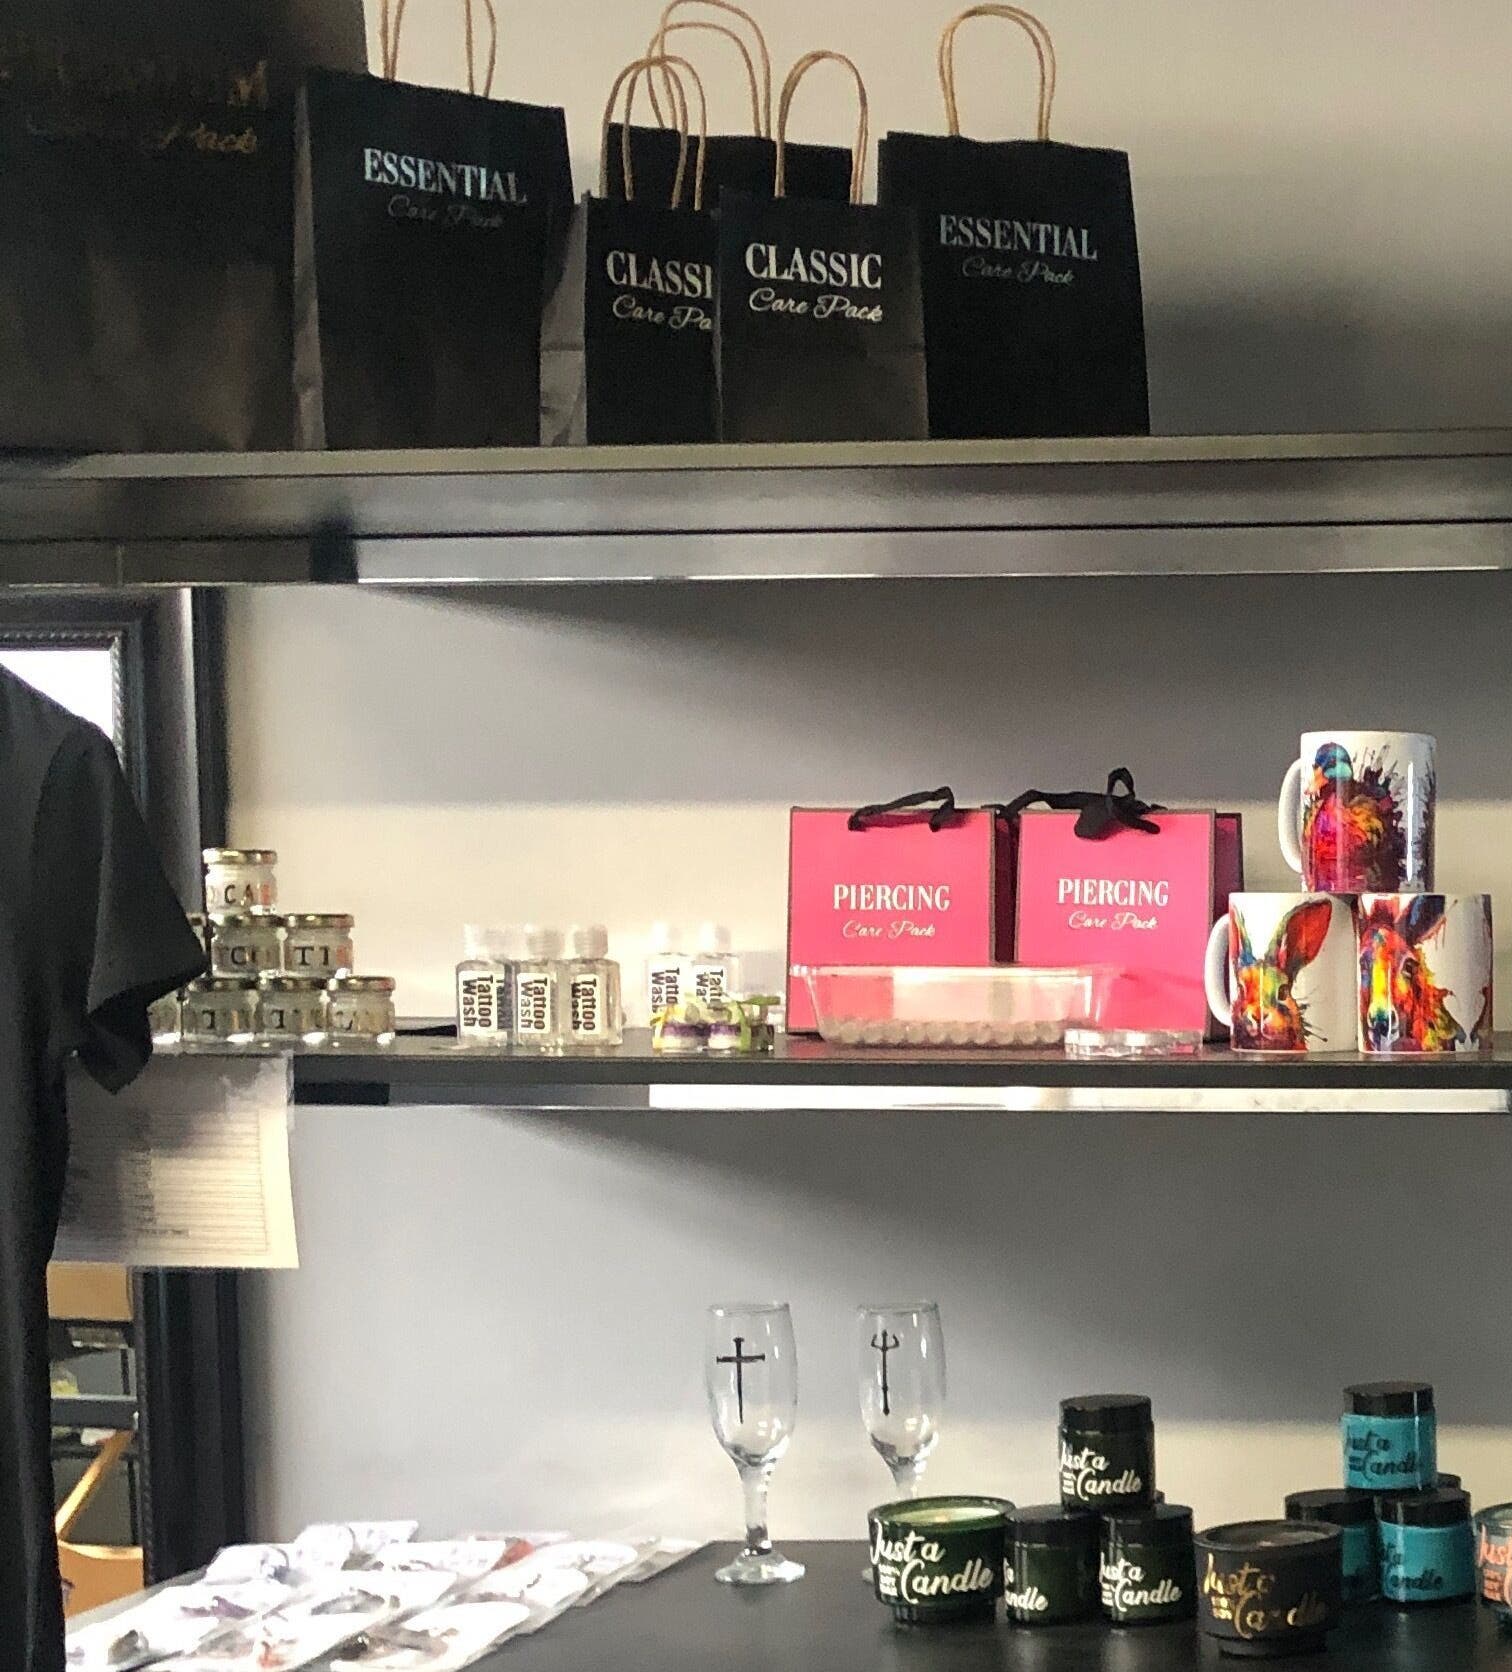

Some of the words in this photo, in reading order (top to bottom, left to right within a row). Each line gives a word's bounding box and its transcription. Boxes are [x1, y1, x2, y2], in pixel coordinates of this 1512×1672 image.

[364, 148, 528, 204] ESSENTIAL
[940, 214, 1098, 262] ESSENTIAL
[606, 250, 713, 299] CLASSI
[745, 242, 882, 290] CLASSIC
[962, 256, 1012, 279] Care
[1017, 259, 1075, 287] Pack
[612, 294, 664, 324] Care
[669, 306, 712, 330] Pa
[749, 287, 808, 314] Care
[813, 294, 883, 322] Pack
[832, 883, 951, 912] PIERCING
[1057, 878, 1169, 907] PIERCING
[842, 919, 884, 938] Care
[887, 919, 936, 940] Pack
[1068, 910, 1107, 930] Care
[1110, 911, 1158, 931] Pack
[463, 979, 478, 1027] Wash
[478, 974, 494, 1028] Tattoo
[521, 981, 533, 1028] Wash
[533, 977, 548, 1030] Tattoo
[582, 978, 597, 1031] Tattoo
[665, 967, 680, 1005] Tatto
[1059, 1440, 1096, 1472] Just
[1092, 1455, 1110, 1471] a
[1362, 1450, 1419, 1482] Candl
[1077, 1467, 1143, 1501] Candle
[869, 1518, 926, 1565] Just
[921, 1542, 946, 1562] a
[901, 1558, 993, 1604] Candle
[1100, 1551, 1133, 1584] Just
[1128, 1566, 1146, 1582] a
[1115, 1577, 1183, 1612] Candle
